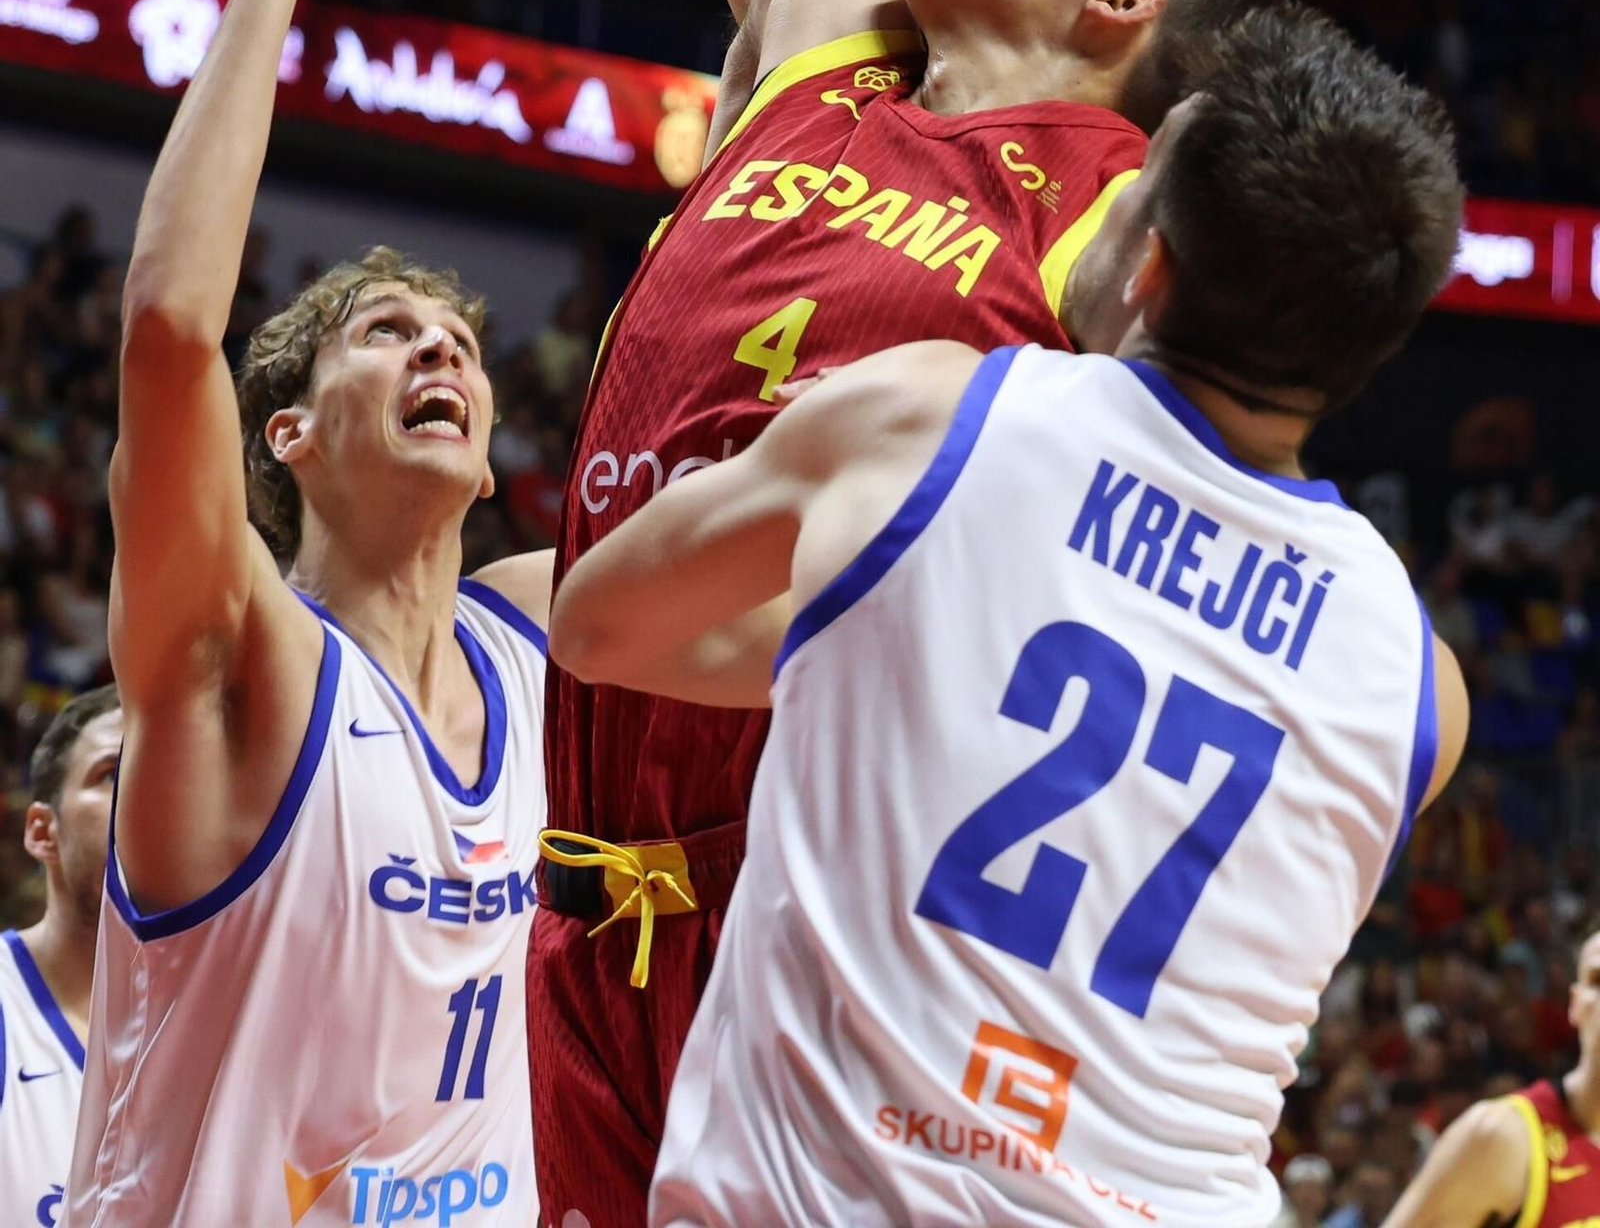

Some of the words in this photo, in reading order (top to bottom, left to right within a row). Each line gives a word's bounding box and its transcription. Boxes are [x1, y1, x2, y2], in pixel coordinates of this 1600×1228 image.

[702, 159, 1002, 298] ESPAÑA
[733, 298, 817, 402] 4
[580, 438, 735, 515] en
[1067, 459, 1337, 672] KREJČÍ
[914, 620, 1286, 1020] 27
[369, 852, 538, 926] ČESK
[434, 975, 503, 1102] 11
